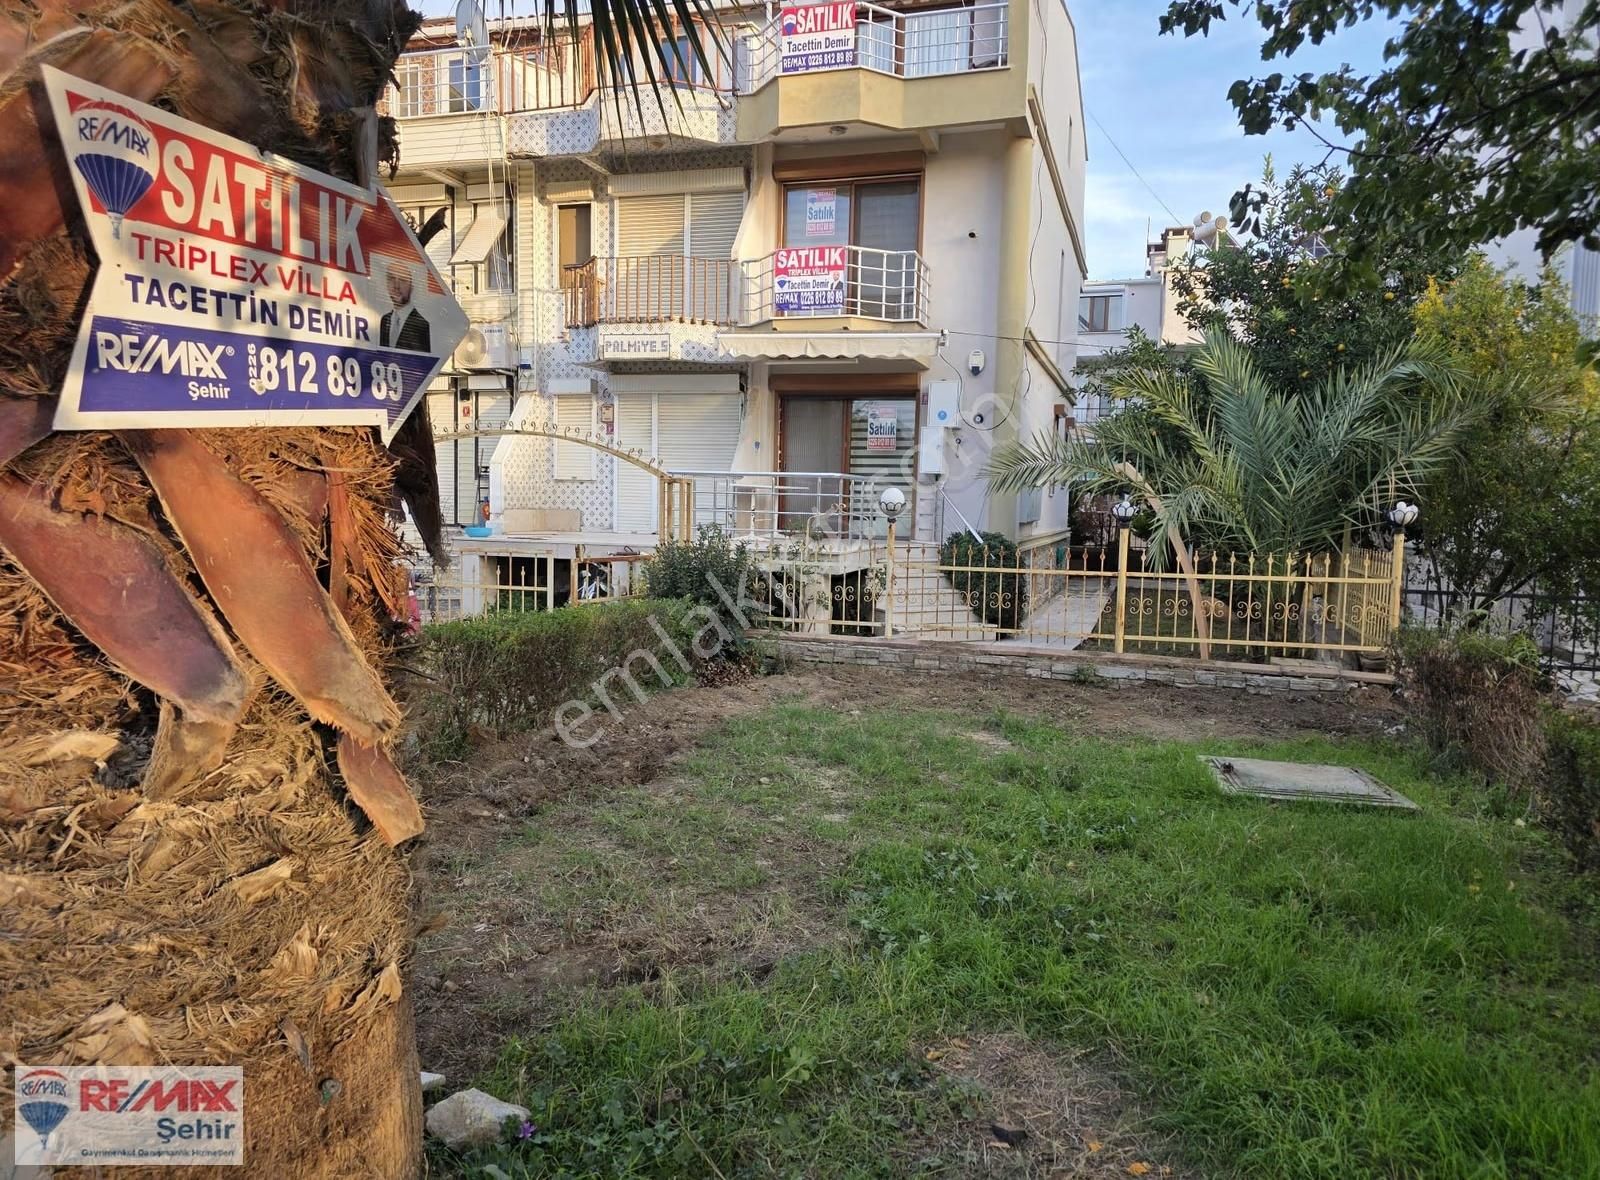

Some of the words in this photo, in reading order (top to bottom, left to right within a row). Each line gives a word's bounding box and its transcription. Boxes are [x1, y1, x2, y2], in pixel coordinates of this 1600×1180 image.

[796, 3, 854, 34] SATILIK
[787, 38, 822, 53] Tacettin
[824, 35, 850, 49] Demir
[783, 56, 807, 69] RE/MAX
[77, 115, 151, 159] RE/MAX
[160, 139, 367, 274] SATILIK
[131, 231, 269, 288] TRİPLEX
[276, 262, 358, 306] VİLLA
[777, 247, 843, 269] SATILIK
[124, 273, 279, 326] TACETTİN
[287, 305, 370, 342] DEMİR
[775, 292, 799, 304] RE/MAX
[95, 331, 229, 380] RE/MAX
[259, 346, 319, 394] 812
[327, 357, 363, 397] 89
[370, 360, 403, 401] 89
[188, 381, 231, 401] Şehir
